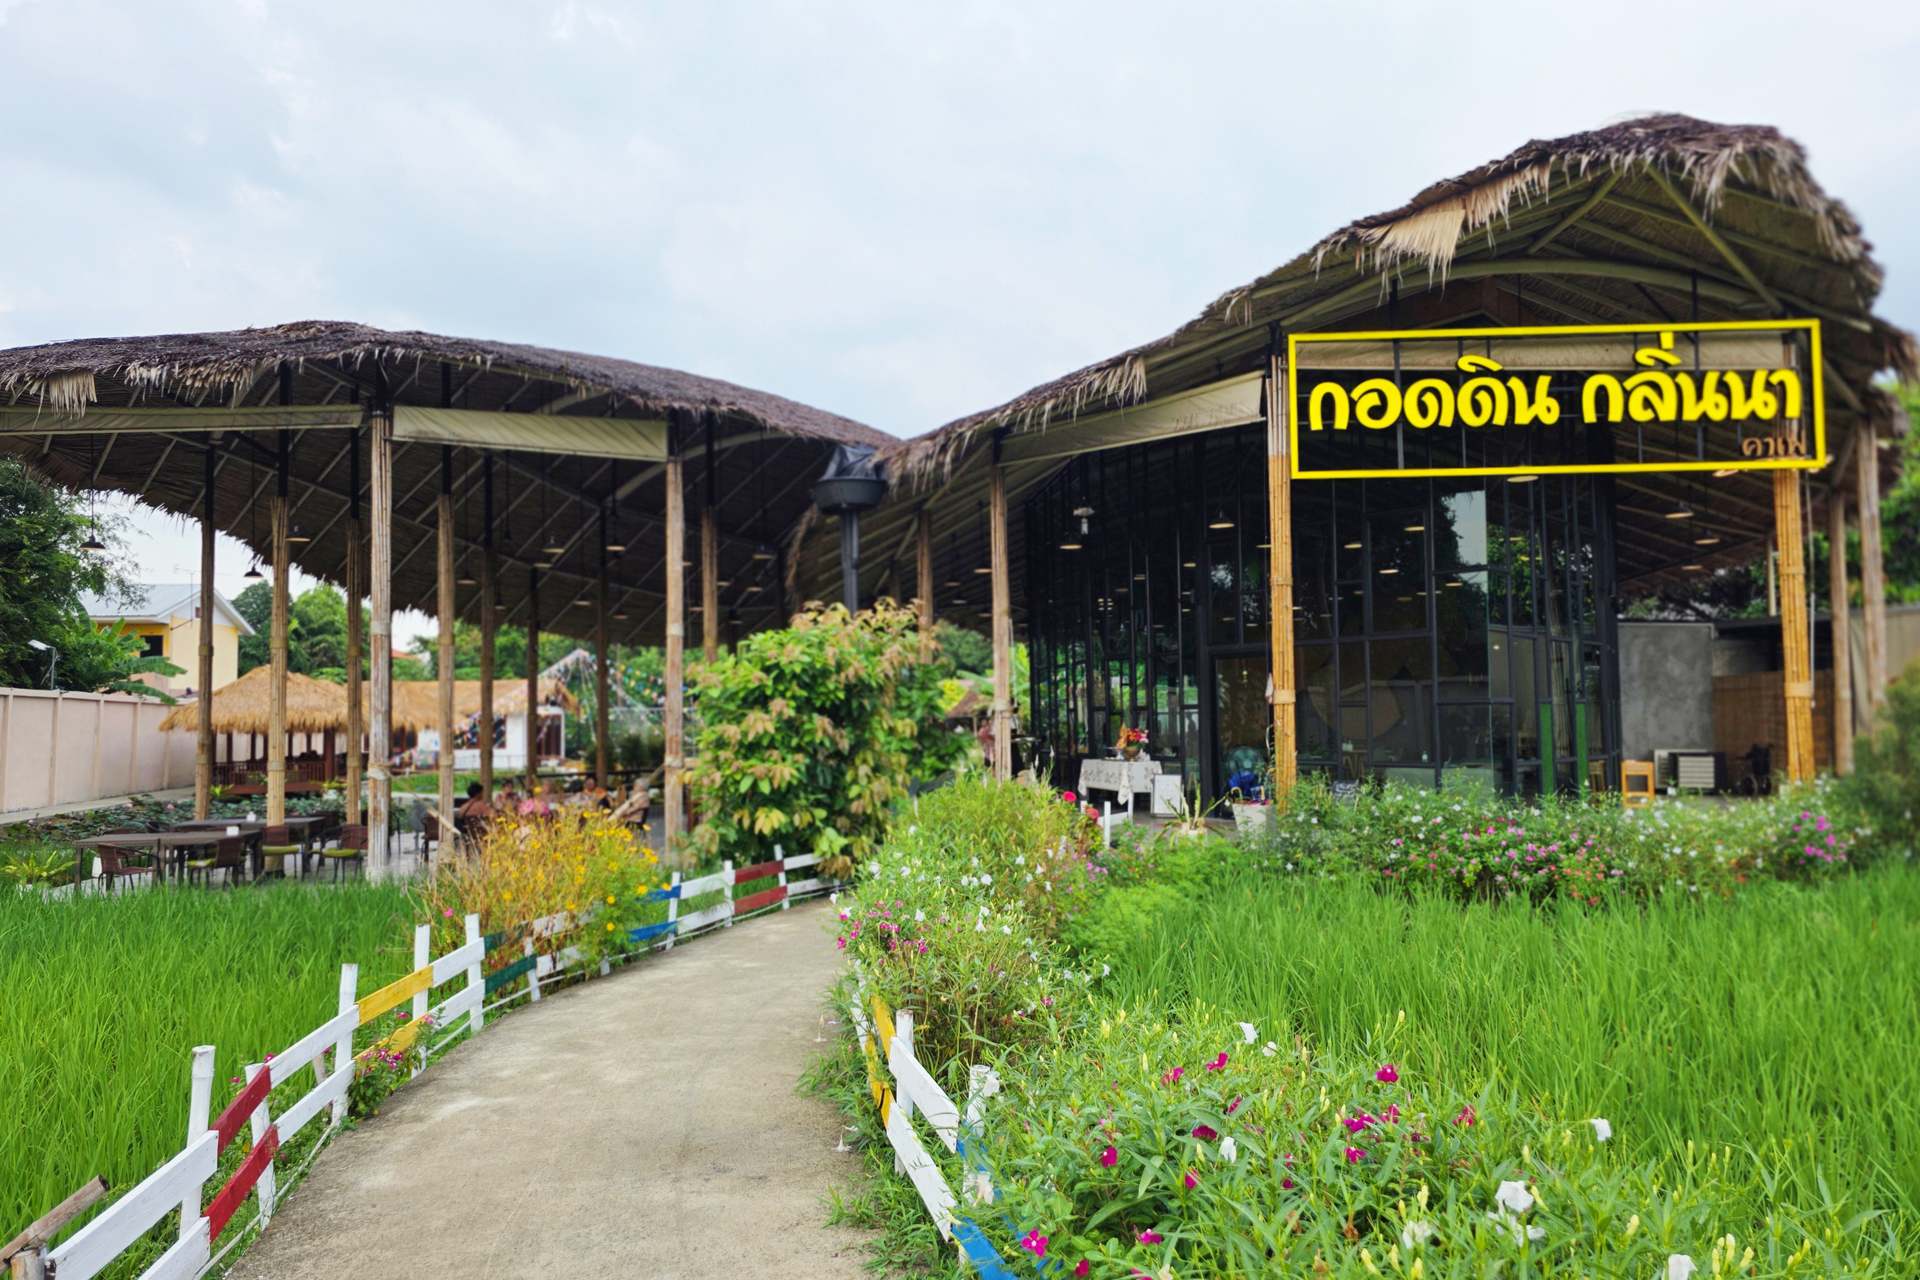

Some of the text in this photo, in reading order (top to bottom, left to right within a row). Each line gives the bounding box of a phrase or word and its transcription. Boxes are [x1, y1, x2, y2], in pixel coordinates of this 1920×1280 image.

[1309, 331, 1802, 431] กอดดิน กลิ่นนา
